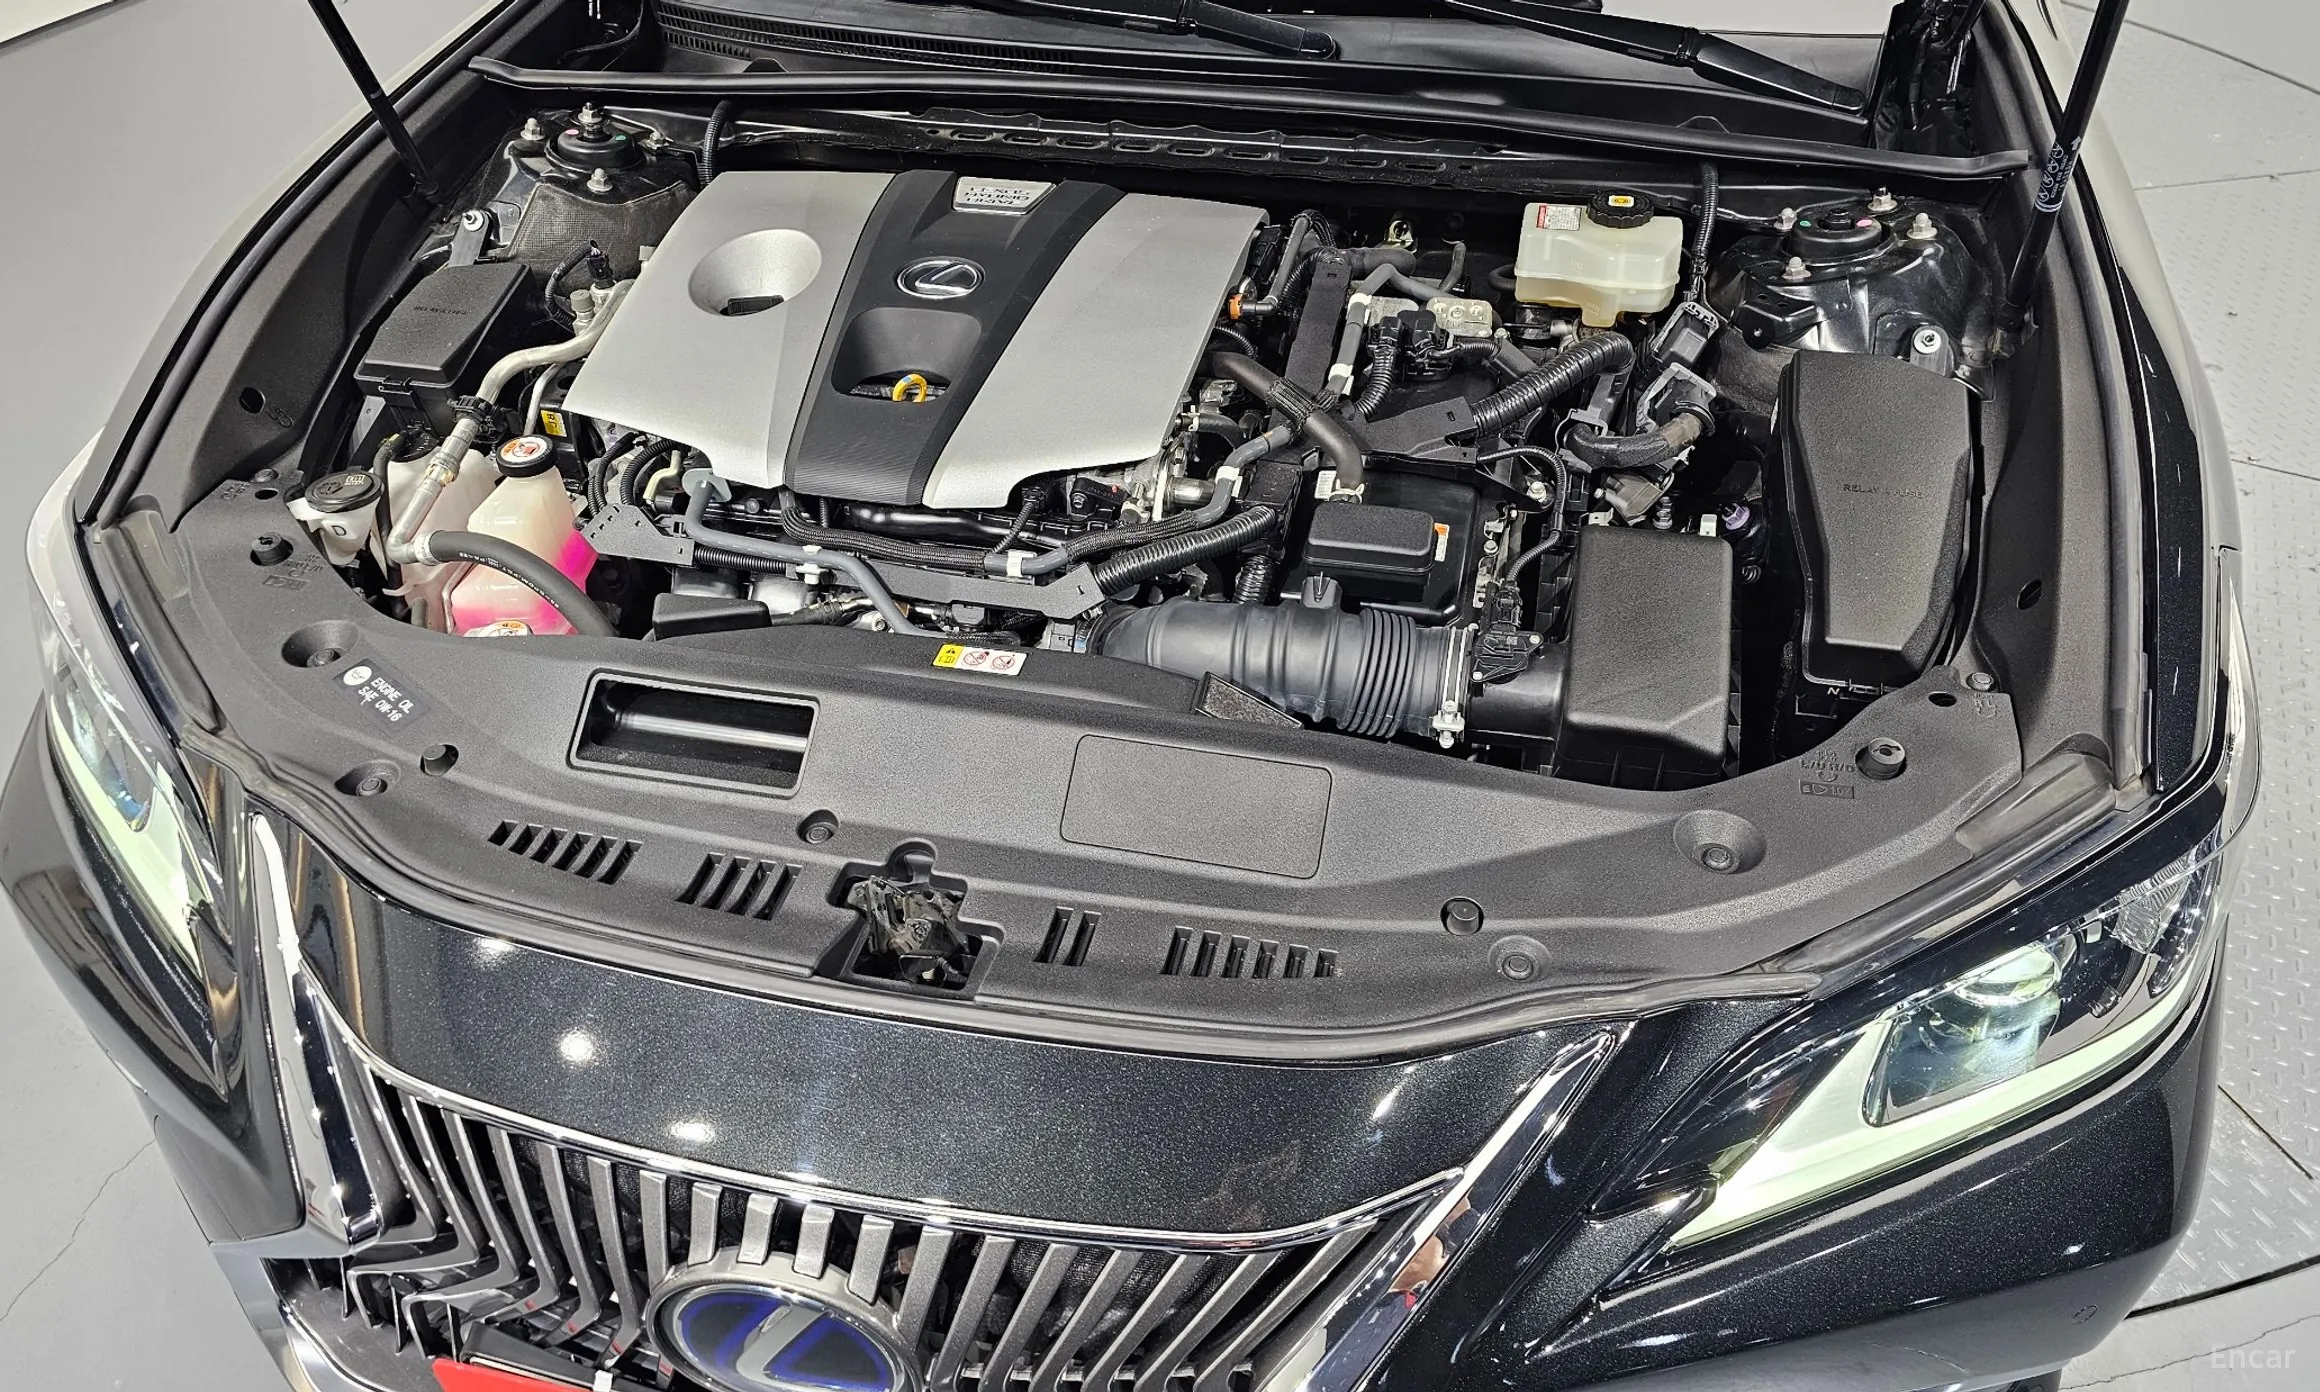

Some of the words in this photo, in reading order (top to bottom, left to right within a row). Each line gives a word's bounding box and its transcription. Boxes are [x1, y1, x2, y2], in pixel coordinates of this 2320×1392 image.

[1843, 484, 1879, 494] RELAY
[358, 686, 379, 703] SAE
[371, 677, 402, 701] ENGINE
[398, 699, 414, 714] OIL
